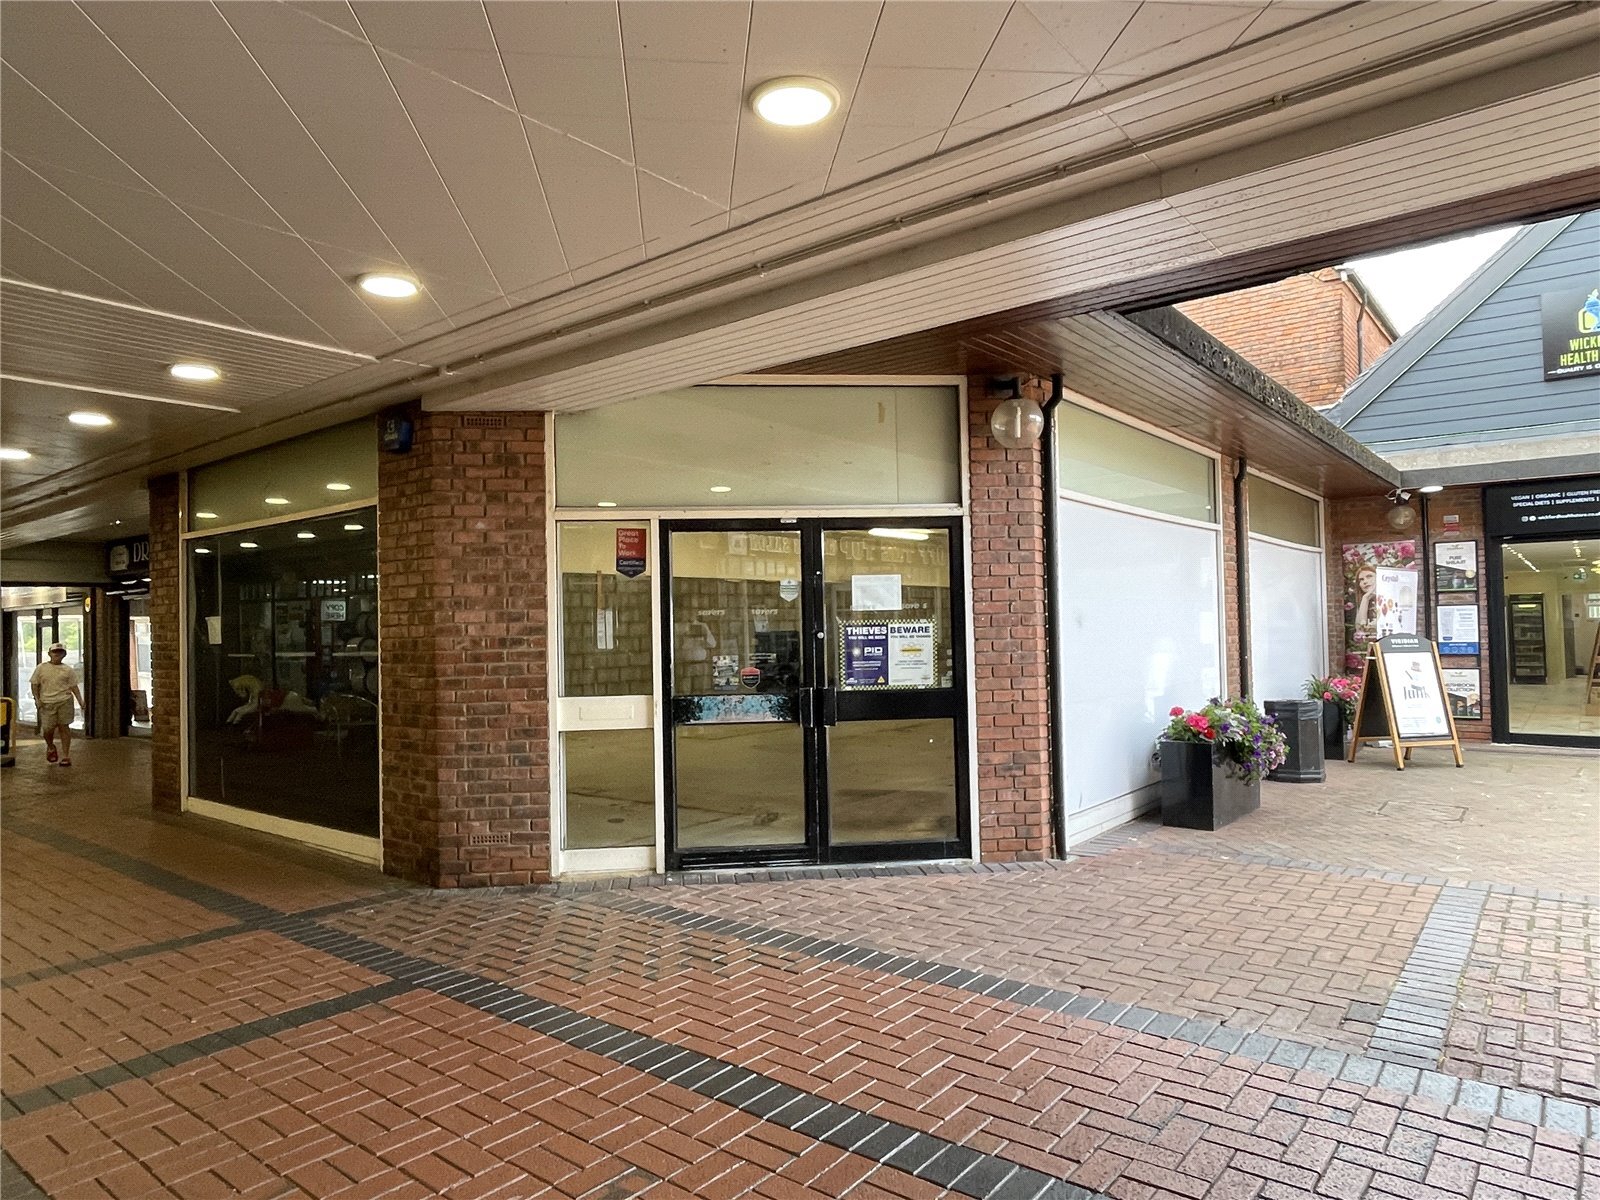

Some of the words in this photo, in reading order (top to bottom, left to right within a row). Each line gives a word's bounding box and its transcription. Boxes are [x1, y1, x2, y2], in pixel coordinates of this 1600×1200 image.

[1560, 350, 1599, 367] HEALTH
[1556, 365, 1584, 374] QUALITY
[846, 626, 887, 635] THIEVES
[889, 626, 930, 634] BEWARE
